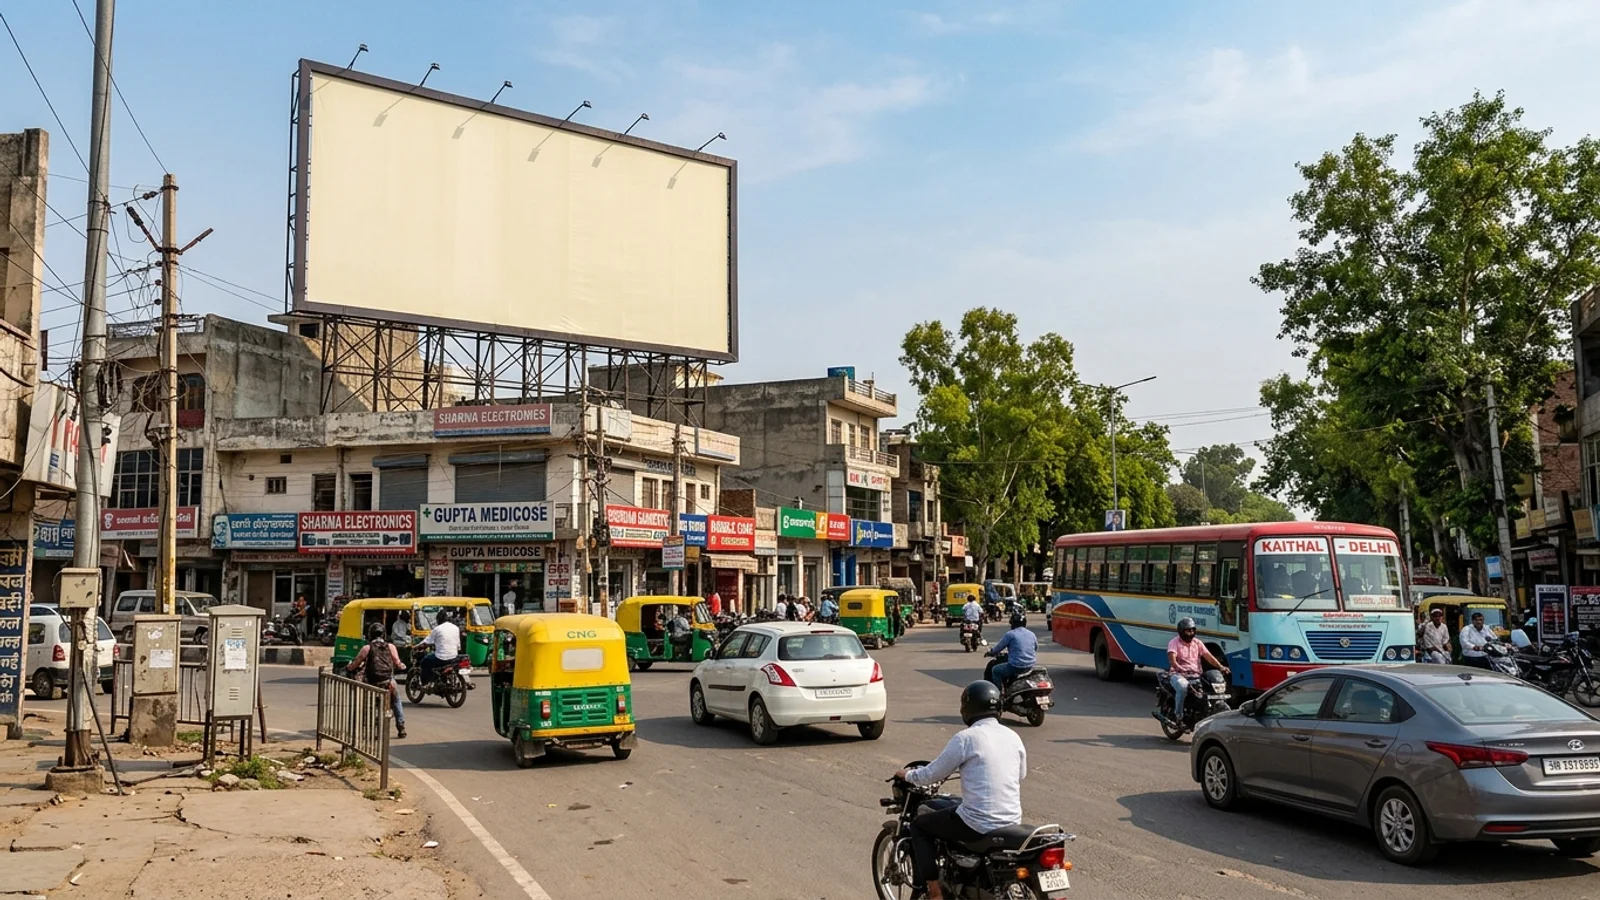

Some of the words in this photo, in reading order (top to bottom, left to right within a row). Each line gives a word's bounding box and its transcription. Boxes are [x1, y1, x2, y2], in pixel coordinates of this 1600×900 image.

[345, 514, 412, 529] ELECTRONICS
[434, 507, 477, 523] GUPTA
[480, 506, 547, 522] MEDICOSE
[451, 547, 485, 557] GUPTA
[1262, 540, 1324, 552] KAITHAL
[1349, 541, 1392, 554] DELHI
[567, 630, 597, 639] CNG
